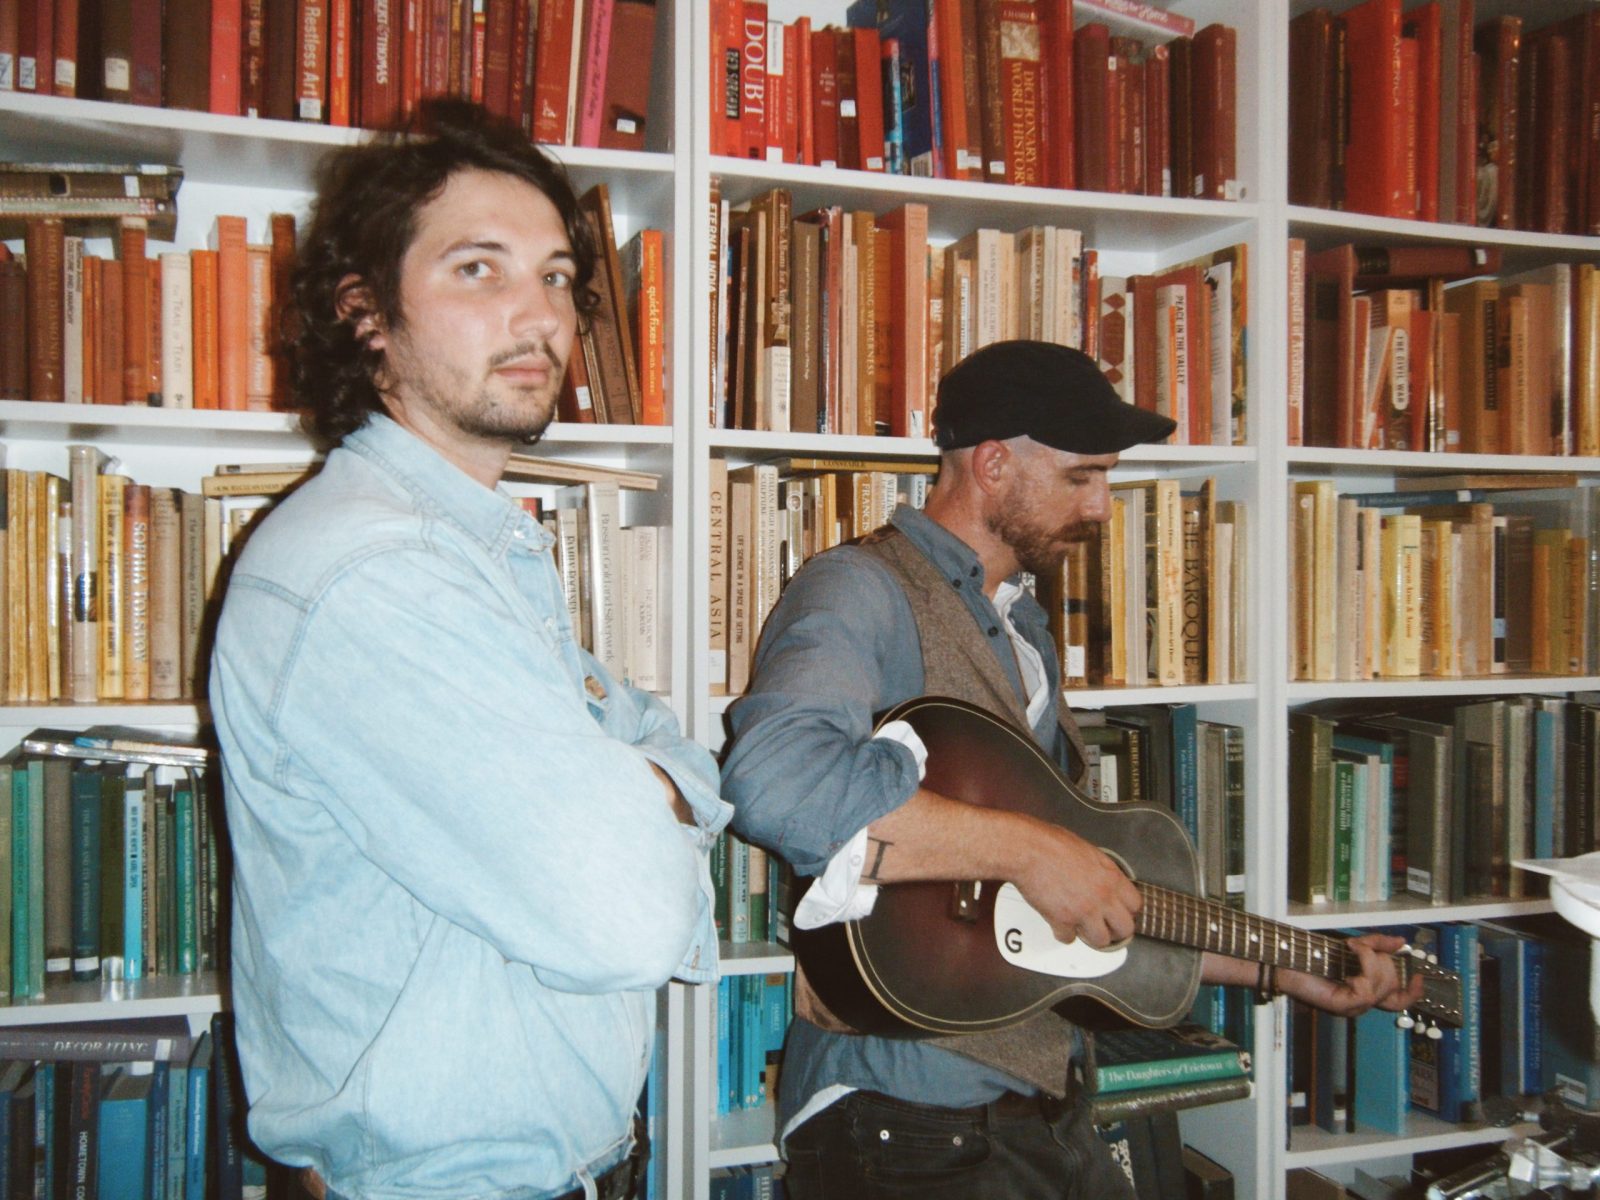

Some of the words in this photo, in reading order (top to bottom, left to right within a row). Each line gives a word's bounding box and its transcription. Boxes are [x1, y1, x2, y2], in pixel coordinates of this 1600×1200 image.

[303, 6, 321, 67] Restless
[376, 36, 388, 84] THOMAS
[744, 18, 765, 123] DOUBT
[1392, 36, 1402, 107] AMERICA
[302, 72, 320, 96] Art
[1011, 62, 1023, 119] WORLD
[1023, 70, 1037, 164] DICTIONARY
[1013, 122, 1026, 187] HISTORY
[709, 202, 718, 255] ETERNAL
[67, 240, 75, 272] CULTURE
[779, 238, 788, 267] Album
[709, 260, 718, 293] INDIA
[866, 248, 875, 305] VANISHING
[1290, 250, 1304, 322] Encyclopedia
[647, 286, 660, 316] quick
[1176, 295, 1184, 321] PEACE
[649, 317, 660, 345] fixes
[867, 309, 875, 376] WILDERNESS
[1176, 324, 1184, 333] IN
[1176, 336, 1184, 351] THE
[1291, 325, 1303, 335] of
[1395, 336, 1405, 351] THE
[1176, 355, 1184, 385] VALLEY
[1290, 340, 1303, 408] Archaeology
[1395, 355, 1405, 379] CIVIL
[1395, 383, 1405, 404] WAR
[861, 482, 871, 531] FRANCIS
[600, 513, 611, 554] Russian
[710, 490, 722, 581] CENTRAL
[736, 534, 744, 546] LIFE
[1183, 508, 1199, 554] THE
[132, 521, 147, 585] SOPHIA
[736, 548, 744, 571] SCIENCE
[602, 557, 613, 583] Gold
[603, 585, 613, 607] and
[736, 588, 744, 606] SPACE
[132, 590, 147, 663] TOLSTOY
[710, 594, 722, 640] ASIA
[736, 608, 744, 619] AGE
[1182, 558, 1201, 667] BAROQUE
[604, 607, 615, 663] Silverwork
[736, 621, 744, 644] SETTING
[1131, 734, 1140, 797] SURREALISM
[184, 809, 192, 827] Latin
[184, 828, 192, 855] American
[184, 856, 192, 885] Literature
[183, 919, 192, 944] Century
[1005, 928, 1022, 953] G
[1109, 1071, 1126, 1083] The
[1126, 1067, 1171, 1084] Daughters
[77, 1131, 88, 1183] HOMETOWN
